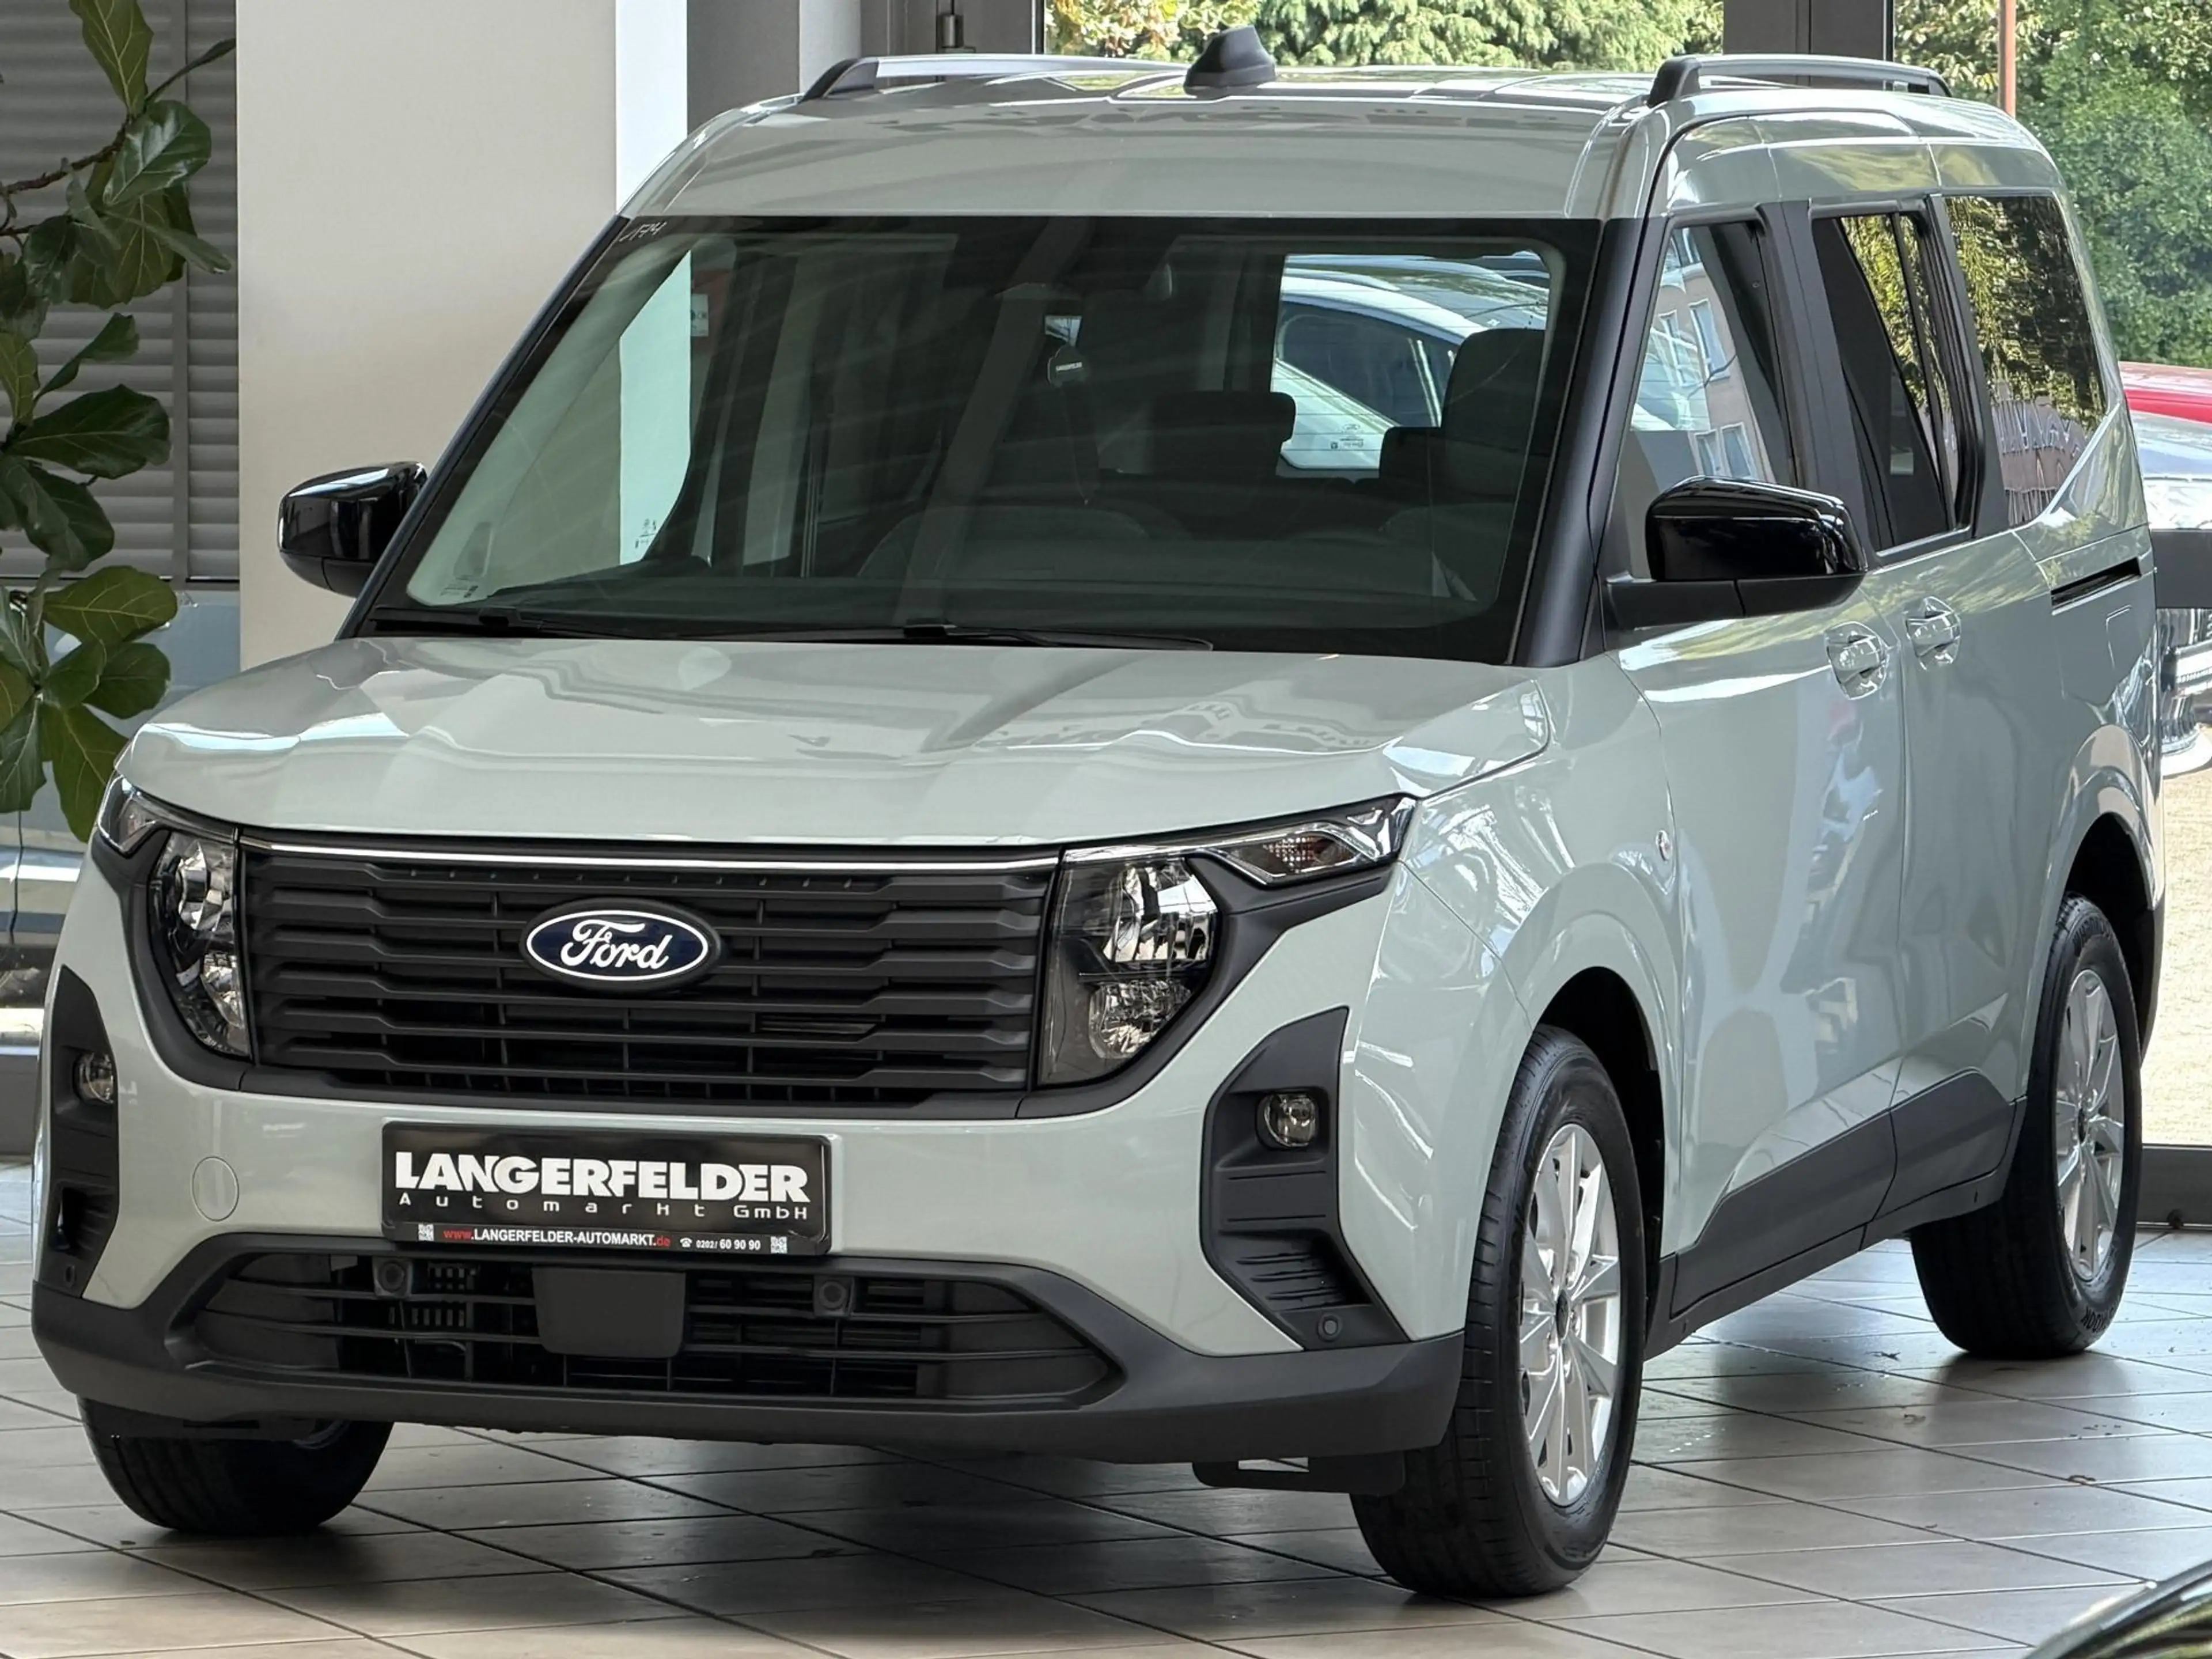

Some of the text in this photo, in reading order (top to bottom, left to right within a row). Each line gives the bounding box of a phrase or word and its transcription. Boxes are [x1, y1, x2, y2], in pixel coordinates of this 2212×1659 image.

[560, 919, 673, 969] Ford
[396, 1152, 811, 1202] LANGERFELDER
[733, 1205, 808, 1220] GmbH
[443, 1229, 671, 1247] www.LANGERFELDER-AUTOMARKT.de
[719, 1238, 732, 1249] 60
[734, 1239, 747, 1250] 90
[748, 1240, 762, 1251] 90
